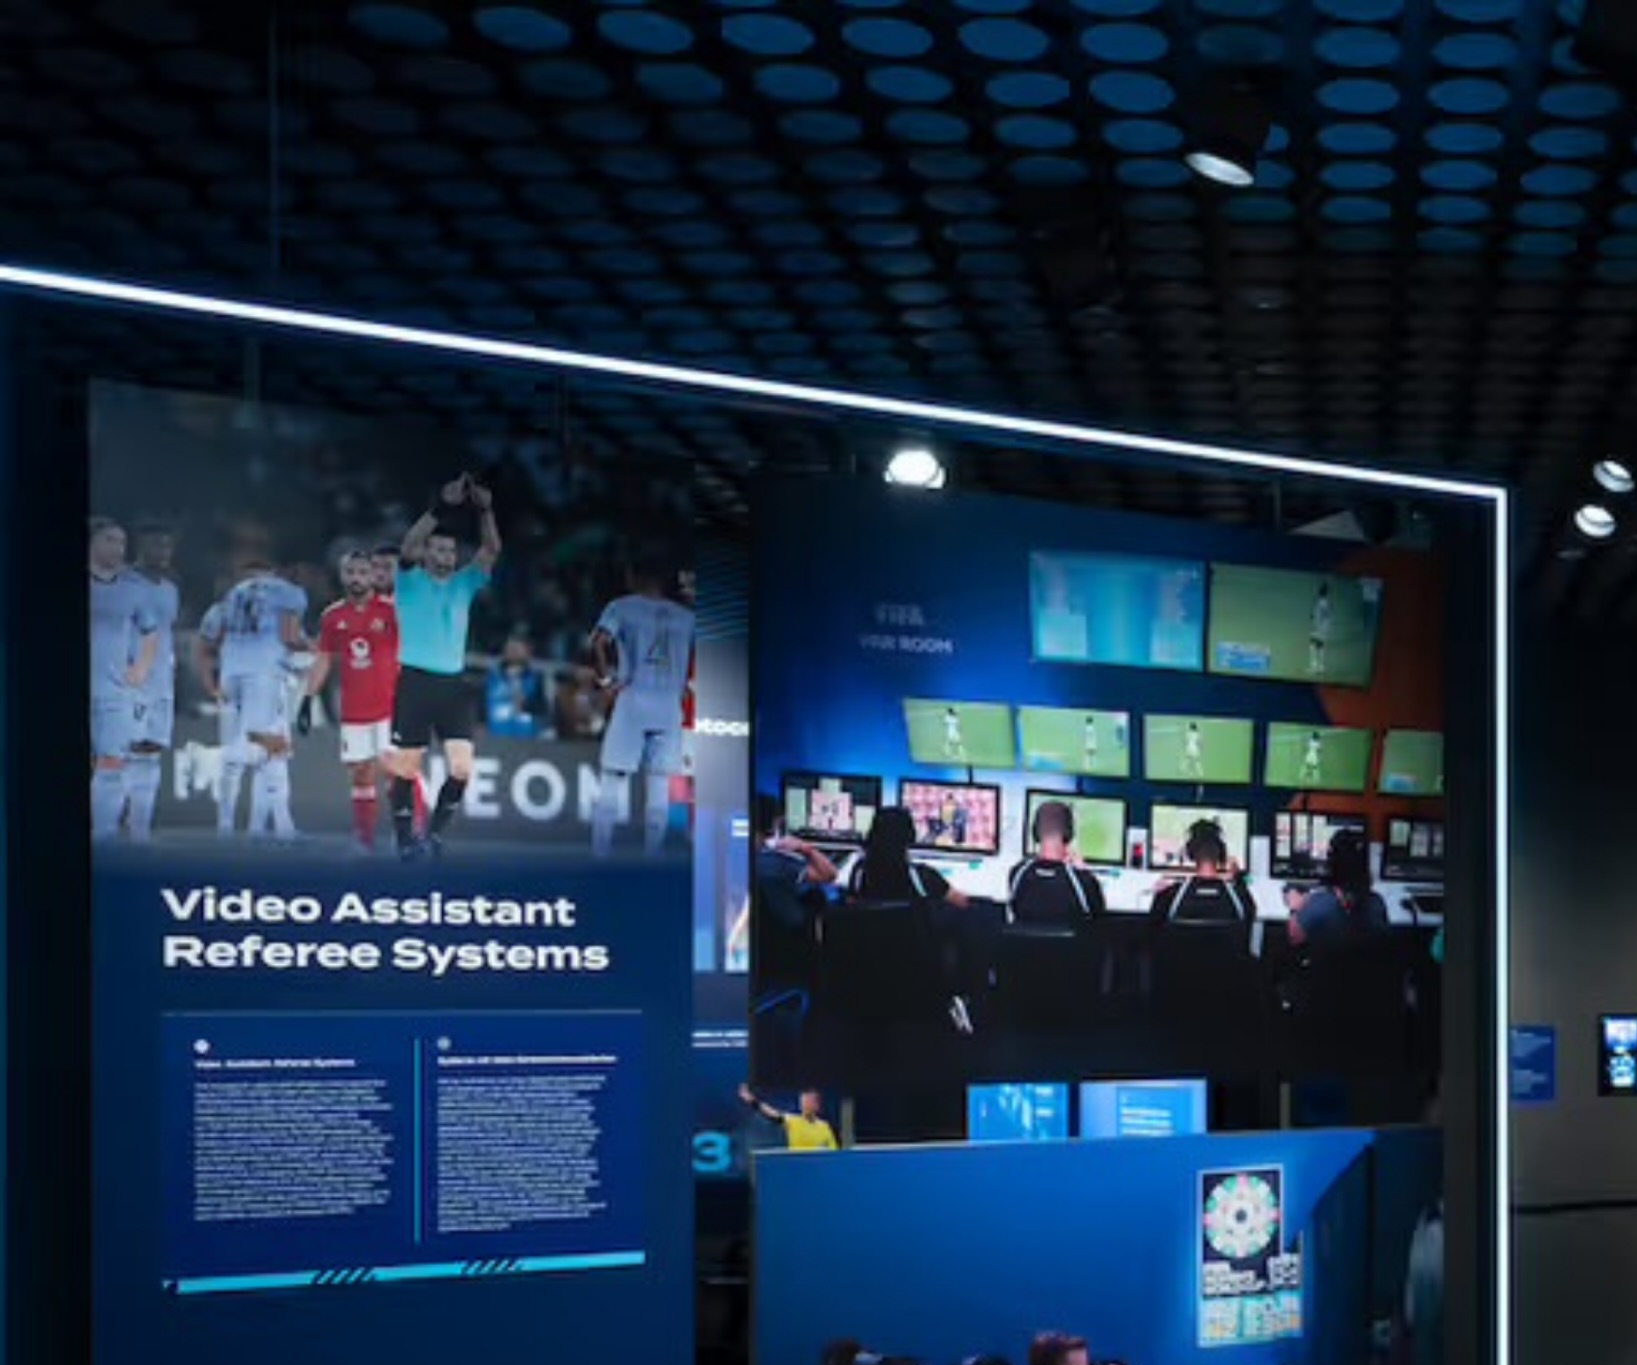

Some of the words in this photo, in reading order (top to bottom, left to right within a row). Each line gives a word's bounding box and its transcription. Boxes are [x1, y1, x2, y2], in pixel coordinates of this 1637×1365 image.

[162, 886, 321, 922] Video
[331, 892, 575, 927] Assistant
[164, 935, 381, 968] Referee
[392, 937, 609, 975] Systems
